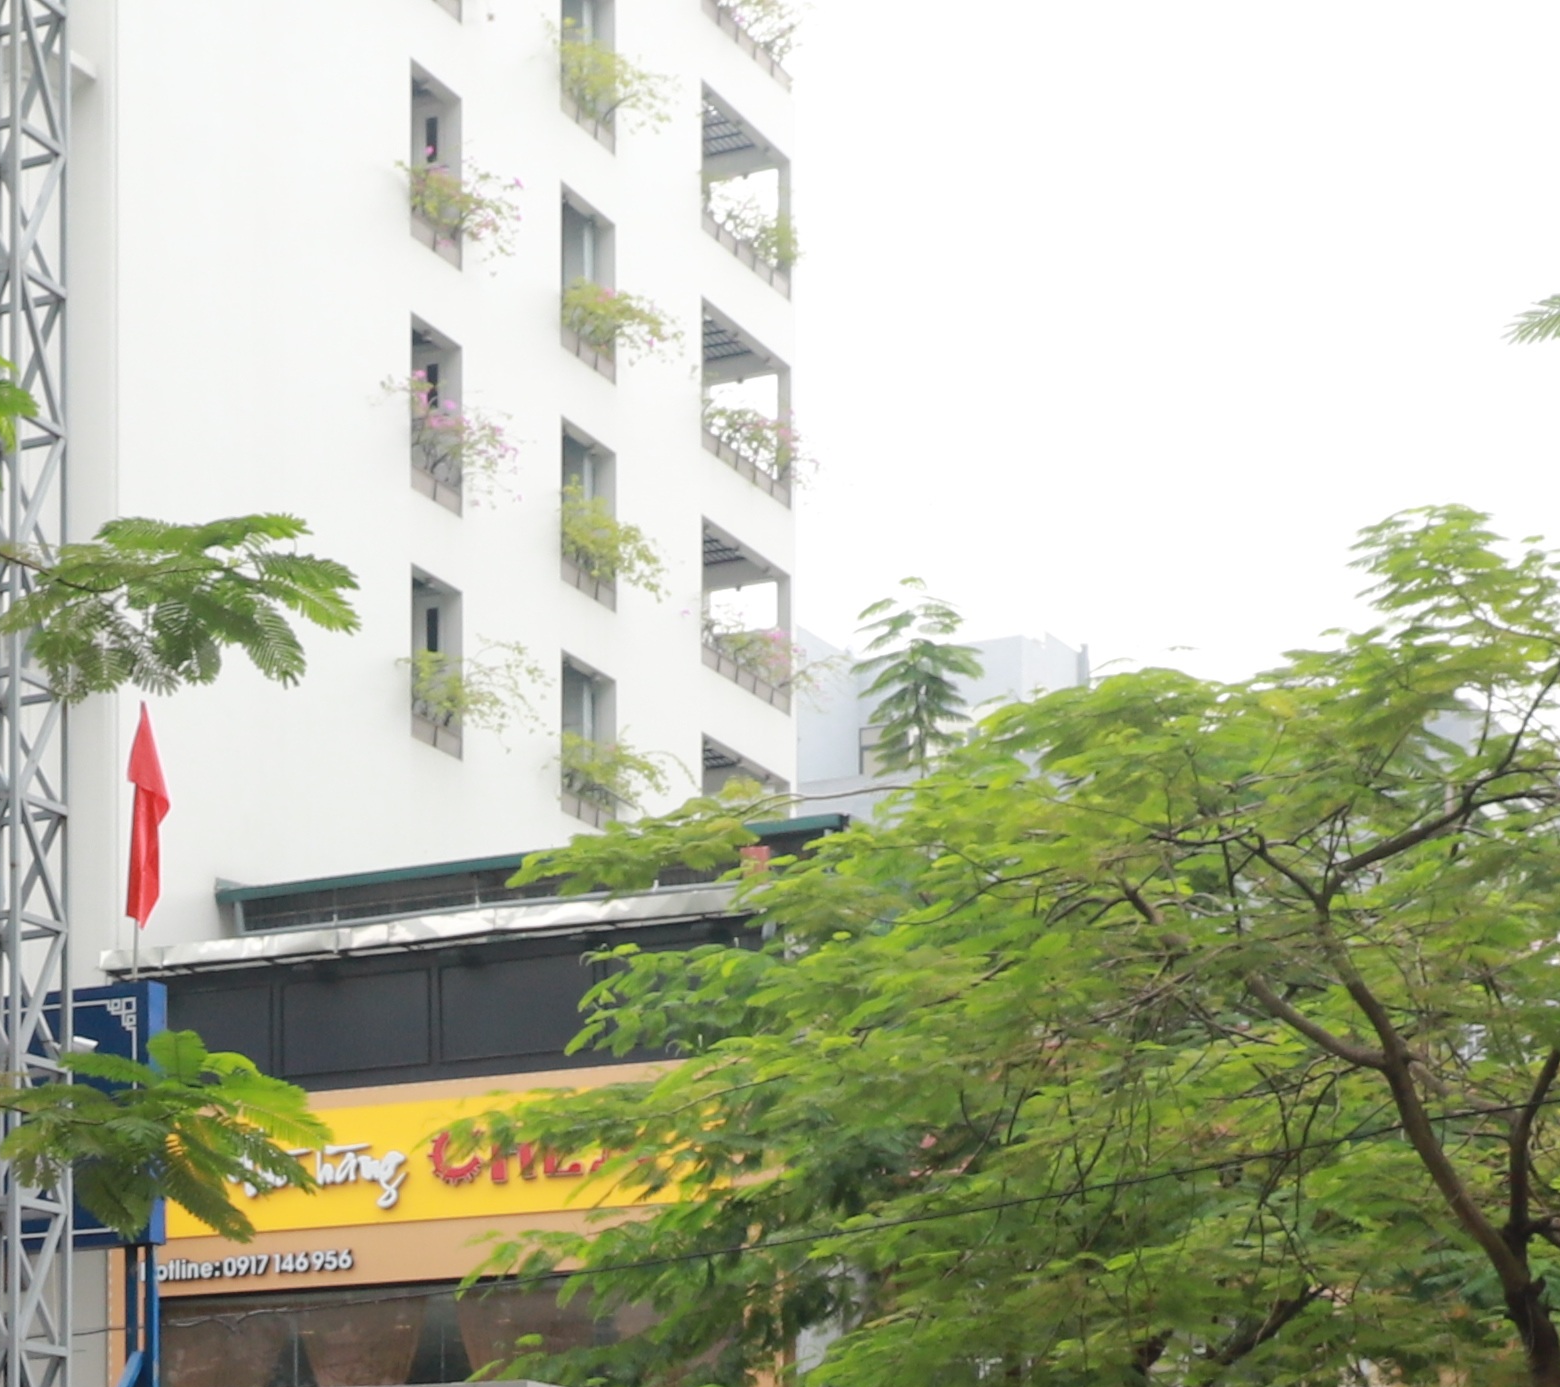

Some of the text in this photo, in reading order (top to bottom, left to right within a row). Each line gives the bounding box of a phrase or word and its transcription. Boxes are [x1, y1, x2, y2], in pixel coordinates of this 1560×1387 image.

[223, 1255, 271, 1279] 0917
[274, 1252, 312, 1275] 146
[313, 1249, 353, 1272] 956
